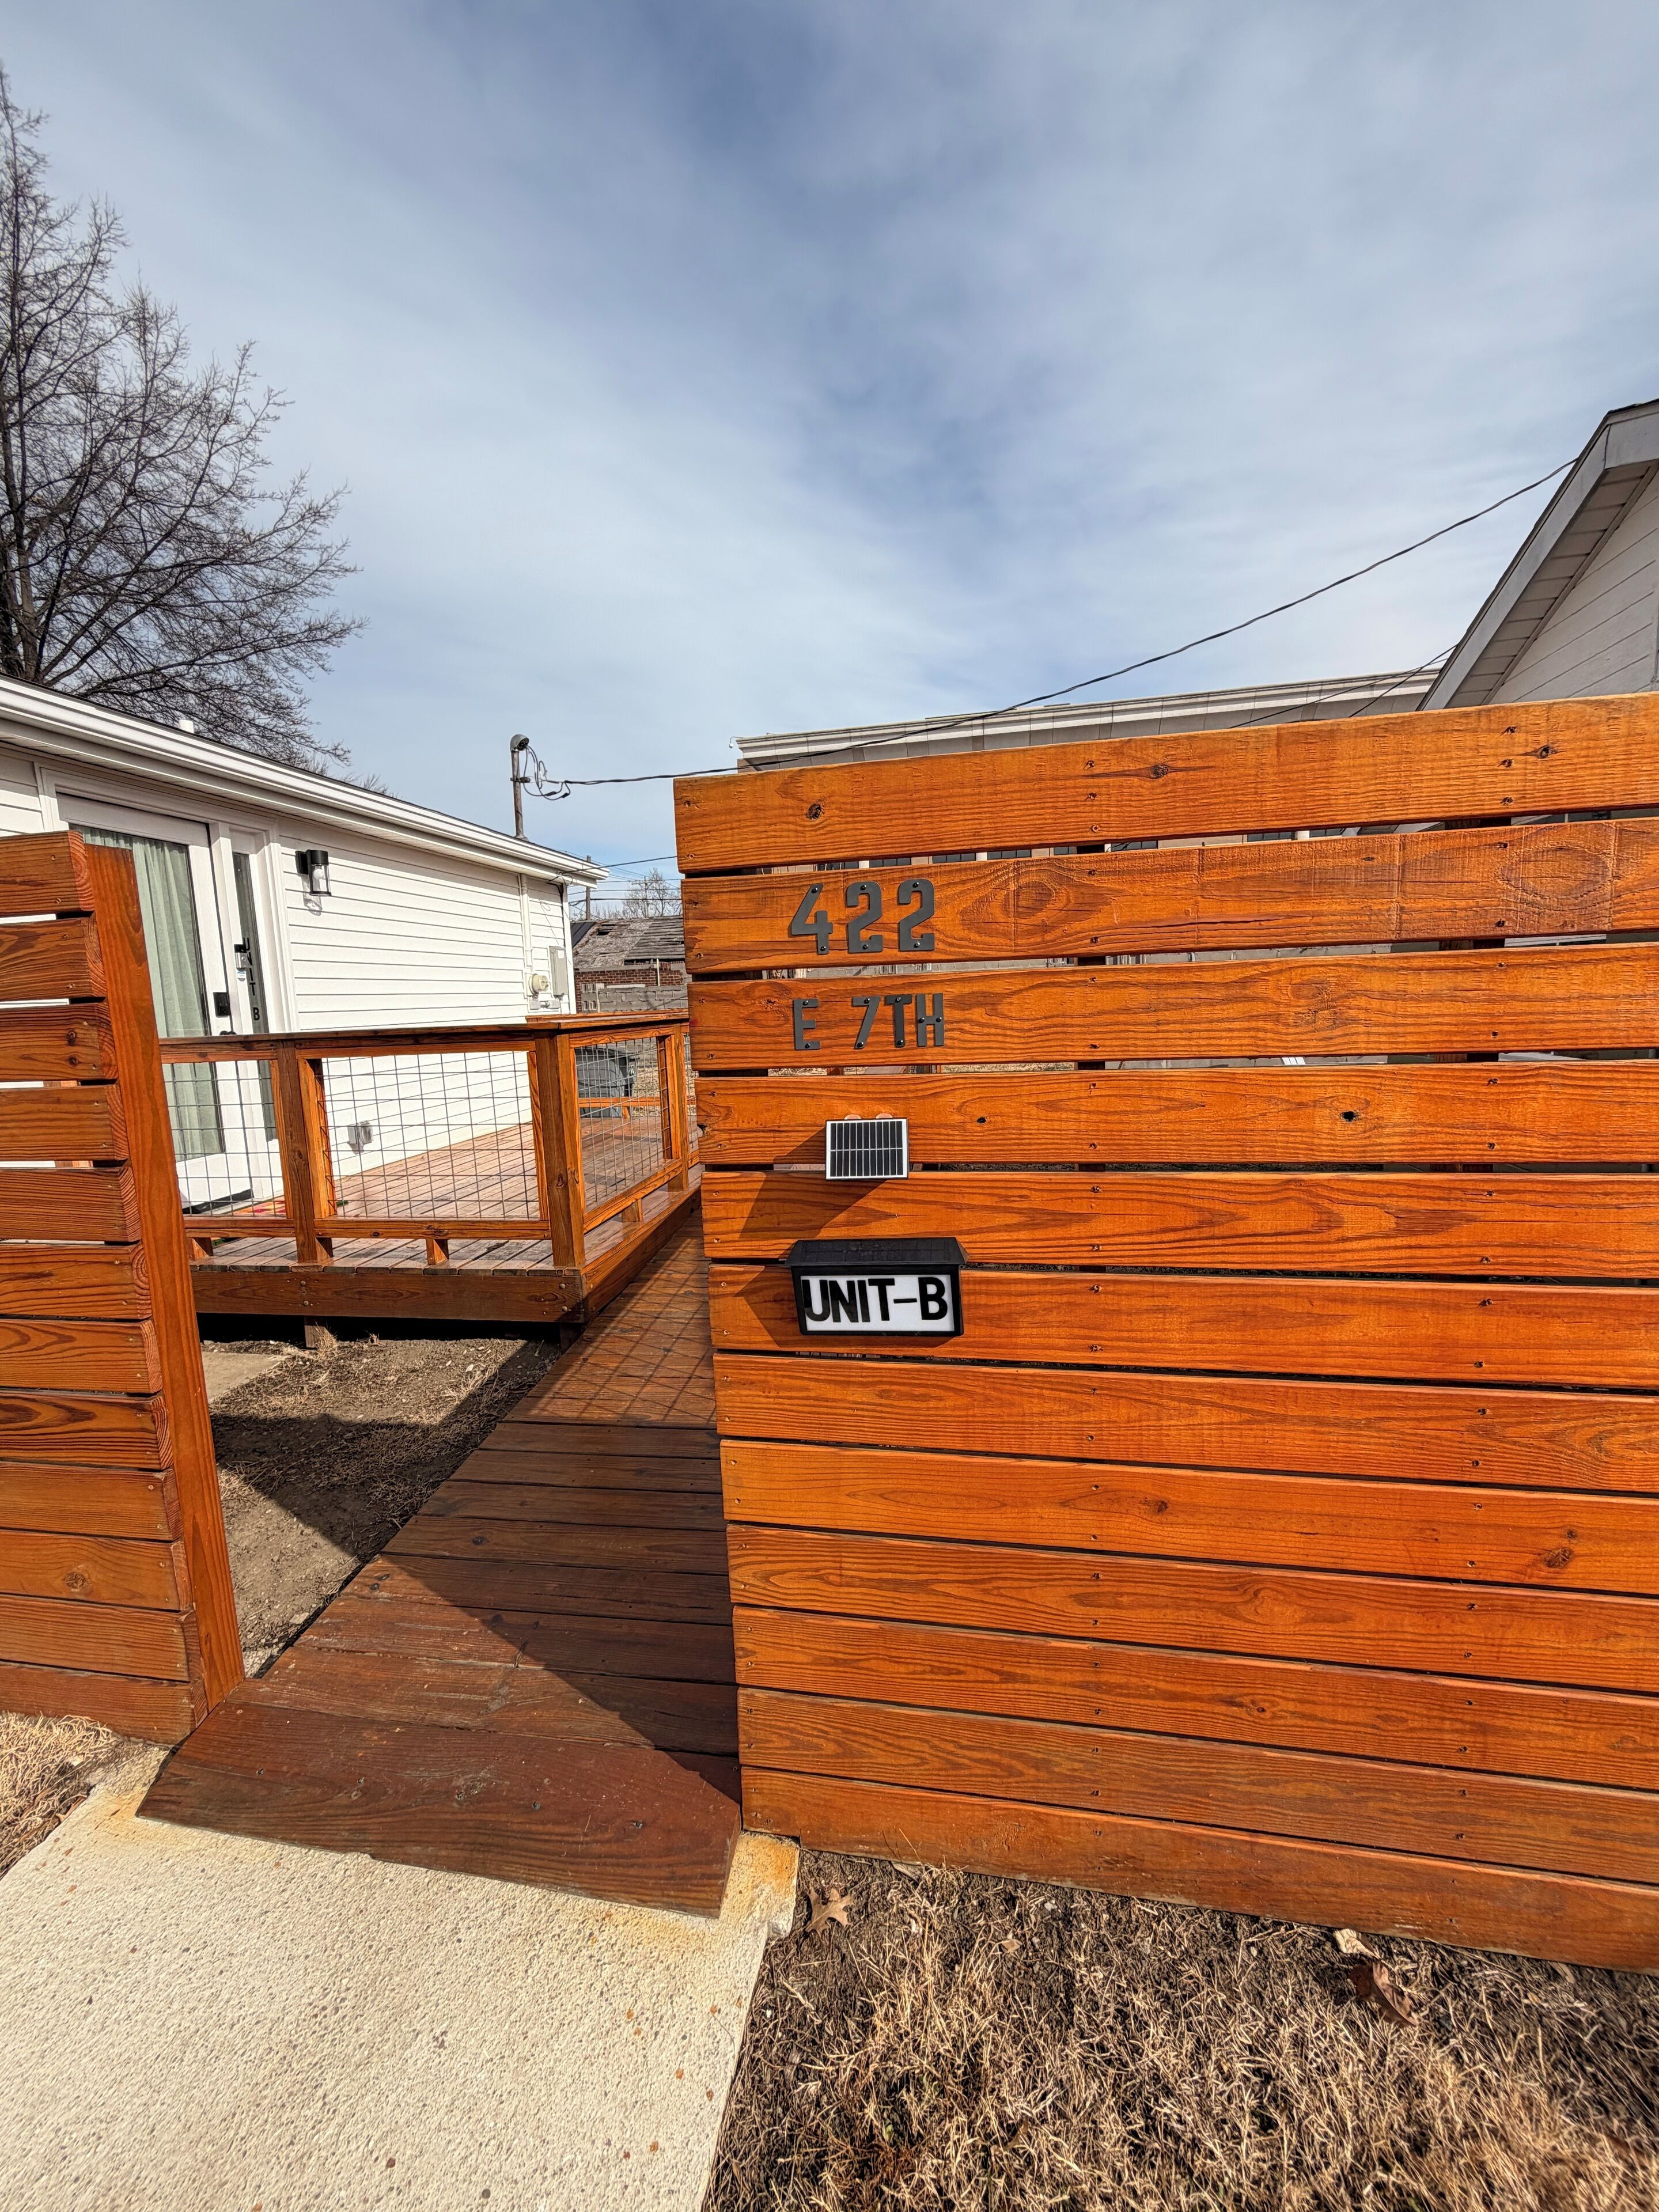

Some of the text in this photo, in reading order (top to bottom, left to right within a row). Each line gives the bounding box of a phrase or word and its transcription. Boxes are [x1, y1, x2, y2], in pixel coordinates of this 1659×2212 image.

[791, 878, 935, 955] 422
[253, 1007, 260, 1021] B
[793, 993, 944, 1050] E 7TH
[801, 1277, 948, 1323] UNIT-B
